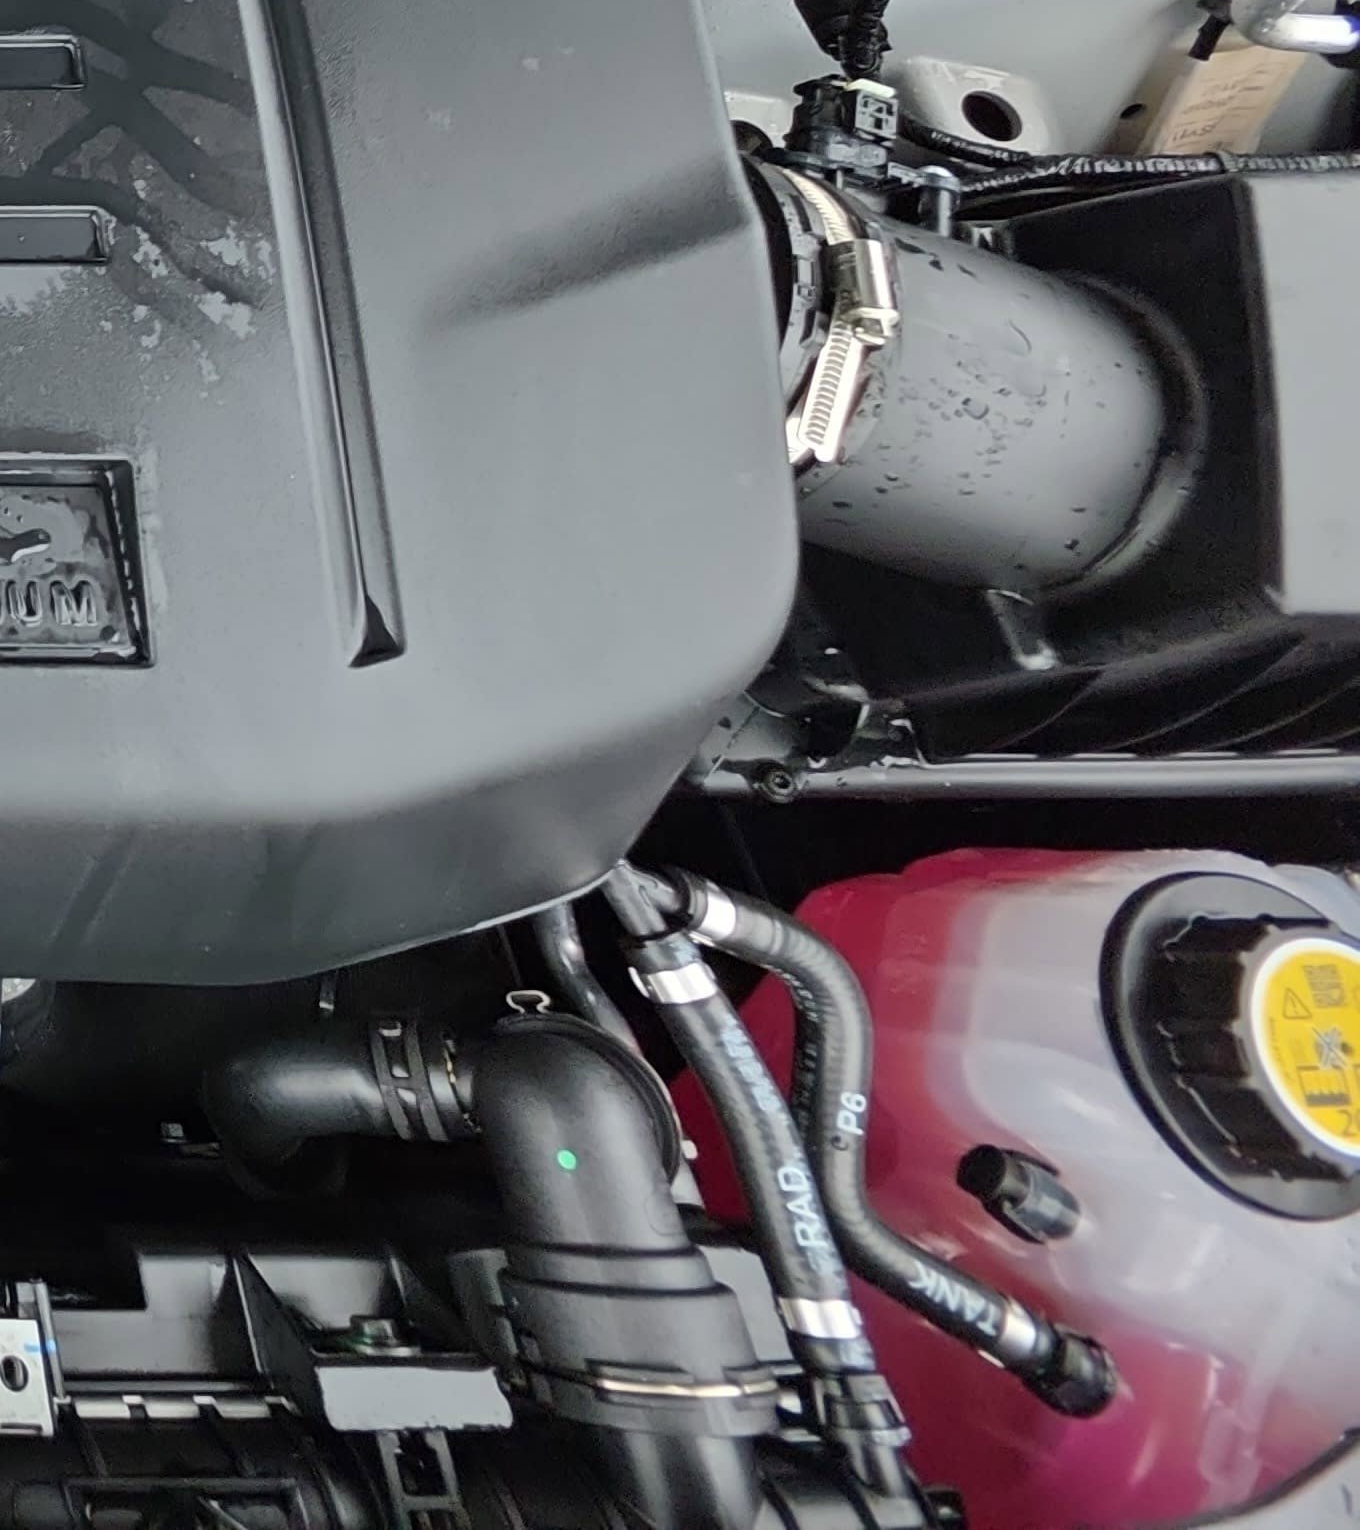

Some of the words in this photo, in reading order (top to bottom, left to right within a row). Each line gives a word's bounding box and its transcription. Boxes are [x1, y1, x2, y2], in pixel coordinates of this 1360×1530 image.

[836, 1091, 866, 1137] P6
[779, 1166, 829, 1248] RAD
[907, 1260, 999, 1337] TANK
